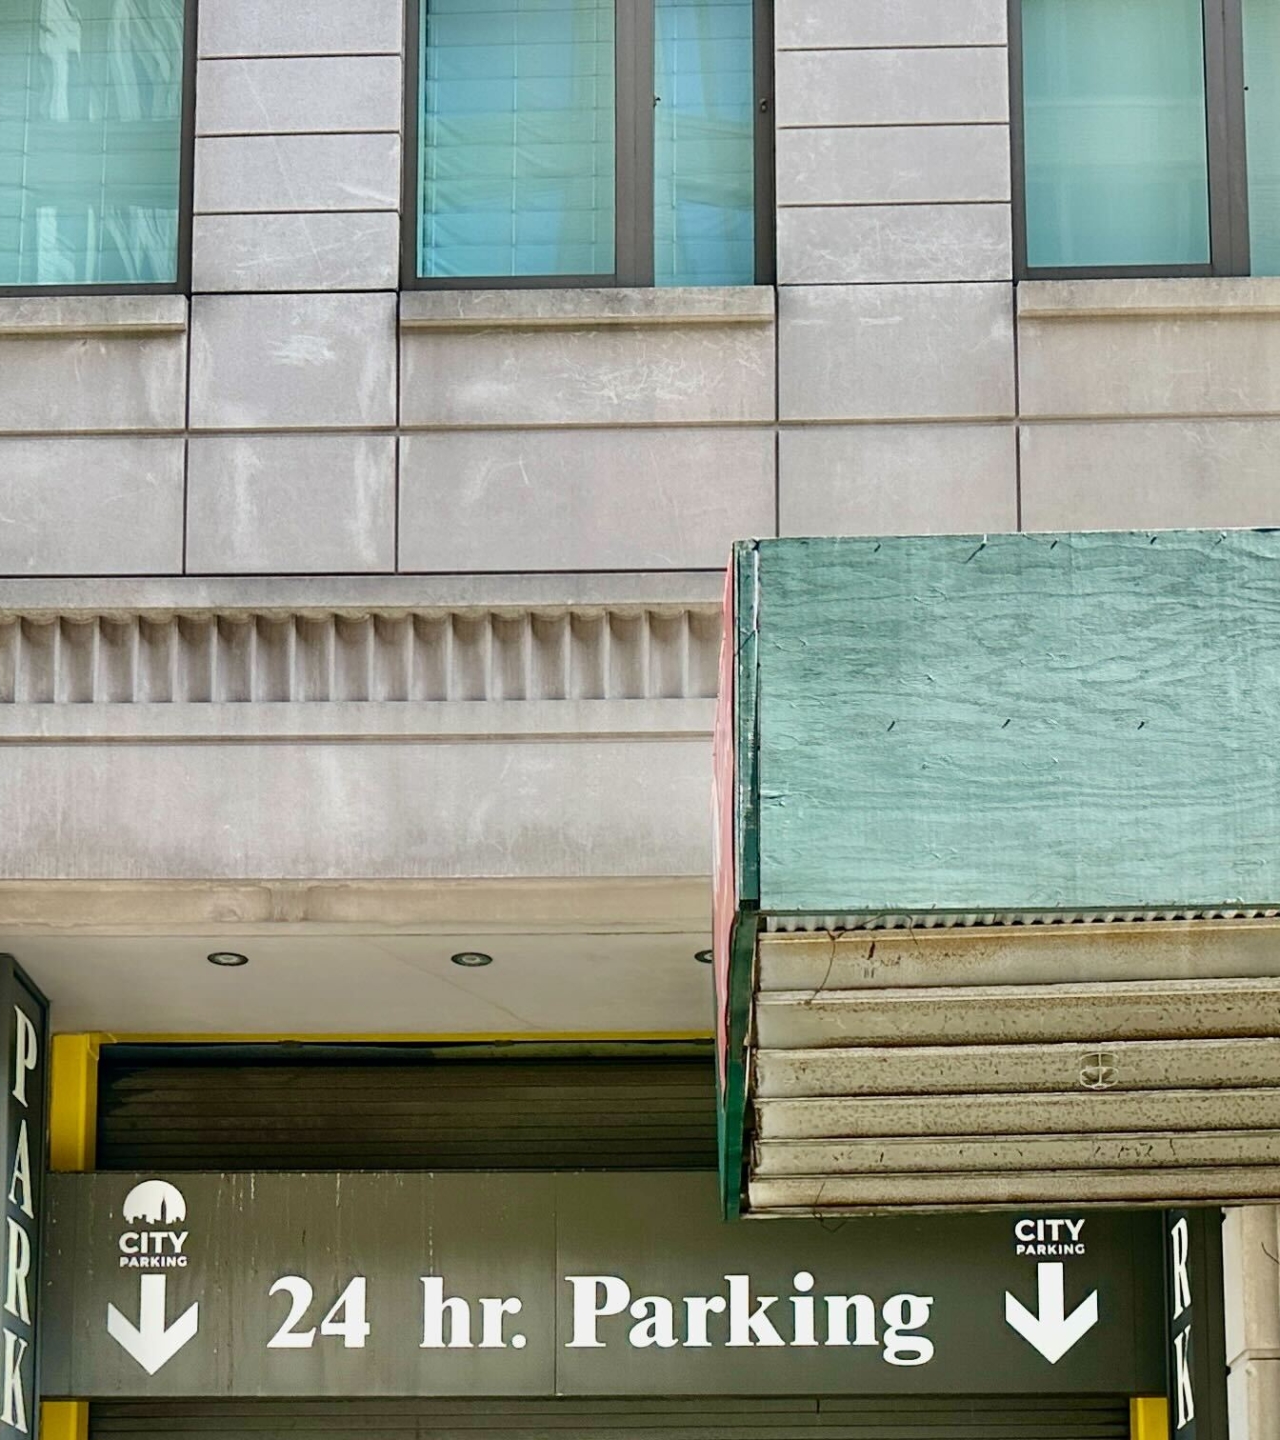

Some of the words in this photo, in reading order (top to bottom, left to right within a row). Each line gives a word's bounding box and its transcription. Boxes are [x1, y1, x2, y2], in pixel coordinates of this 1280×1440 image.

[0, 1004, 38, 1434] PARK
[1014, 1218, 1086, 1242] CITY
[118, 1231, 189, 1254] CITY
[1016, 1243, 1086, 1256] PARKING
[119, 1255, 188, 1268] PARKING
[266, 1274, 371, 1349] 24
[420, 1275, 528, 1350] hr.
[564, 1271, 935, 1366] Parking
[1171, 1217, 1195, 1430] RK
